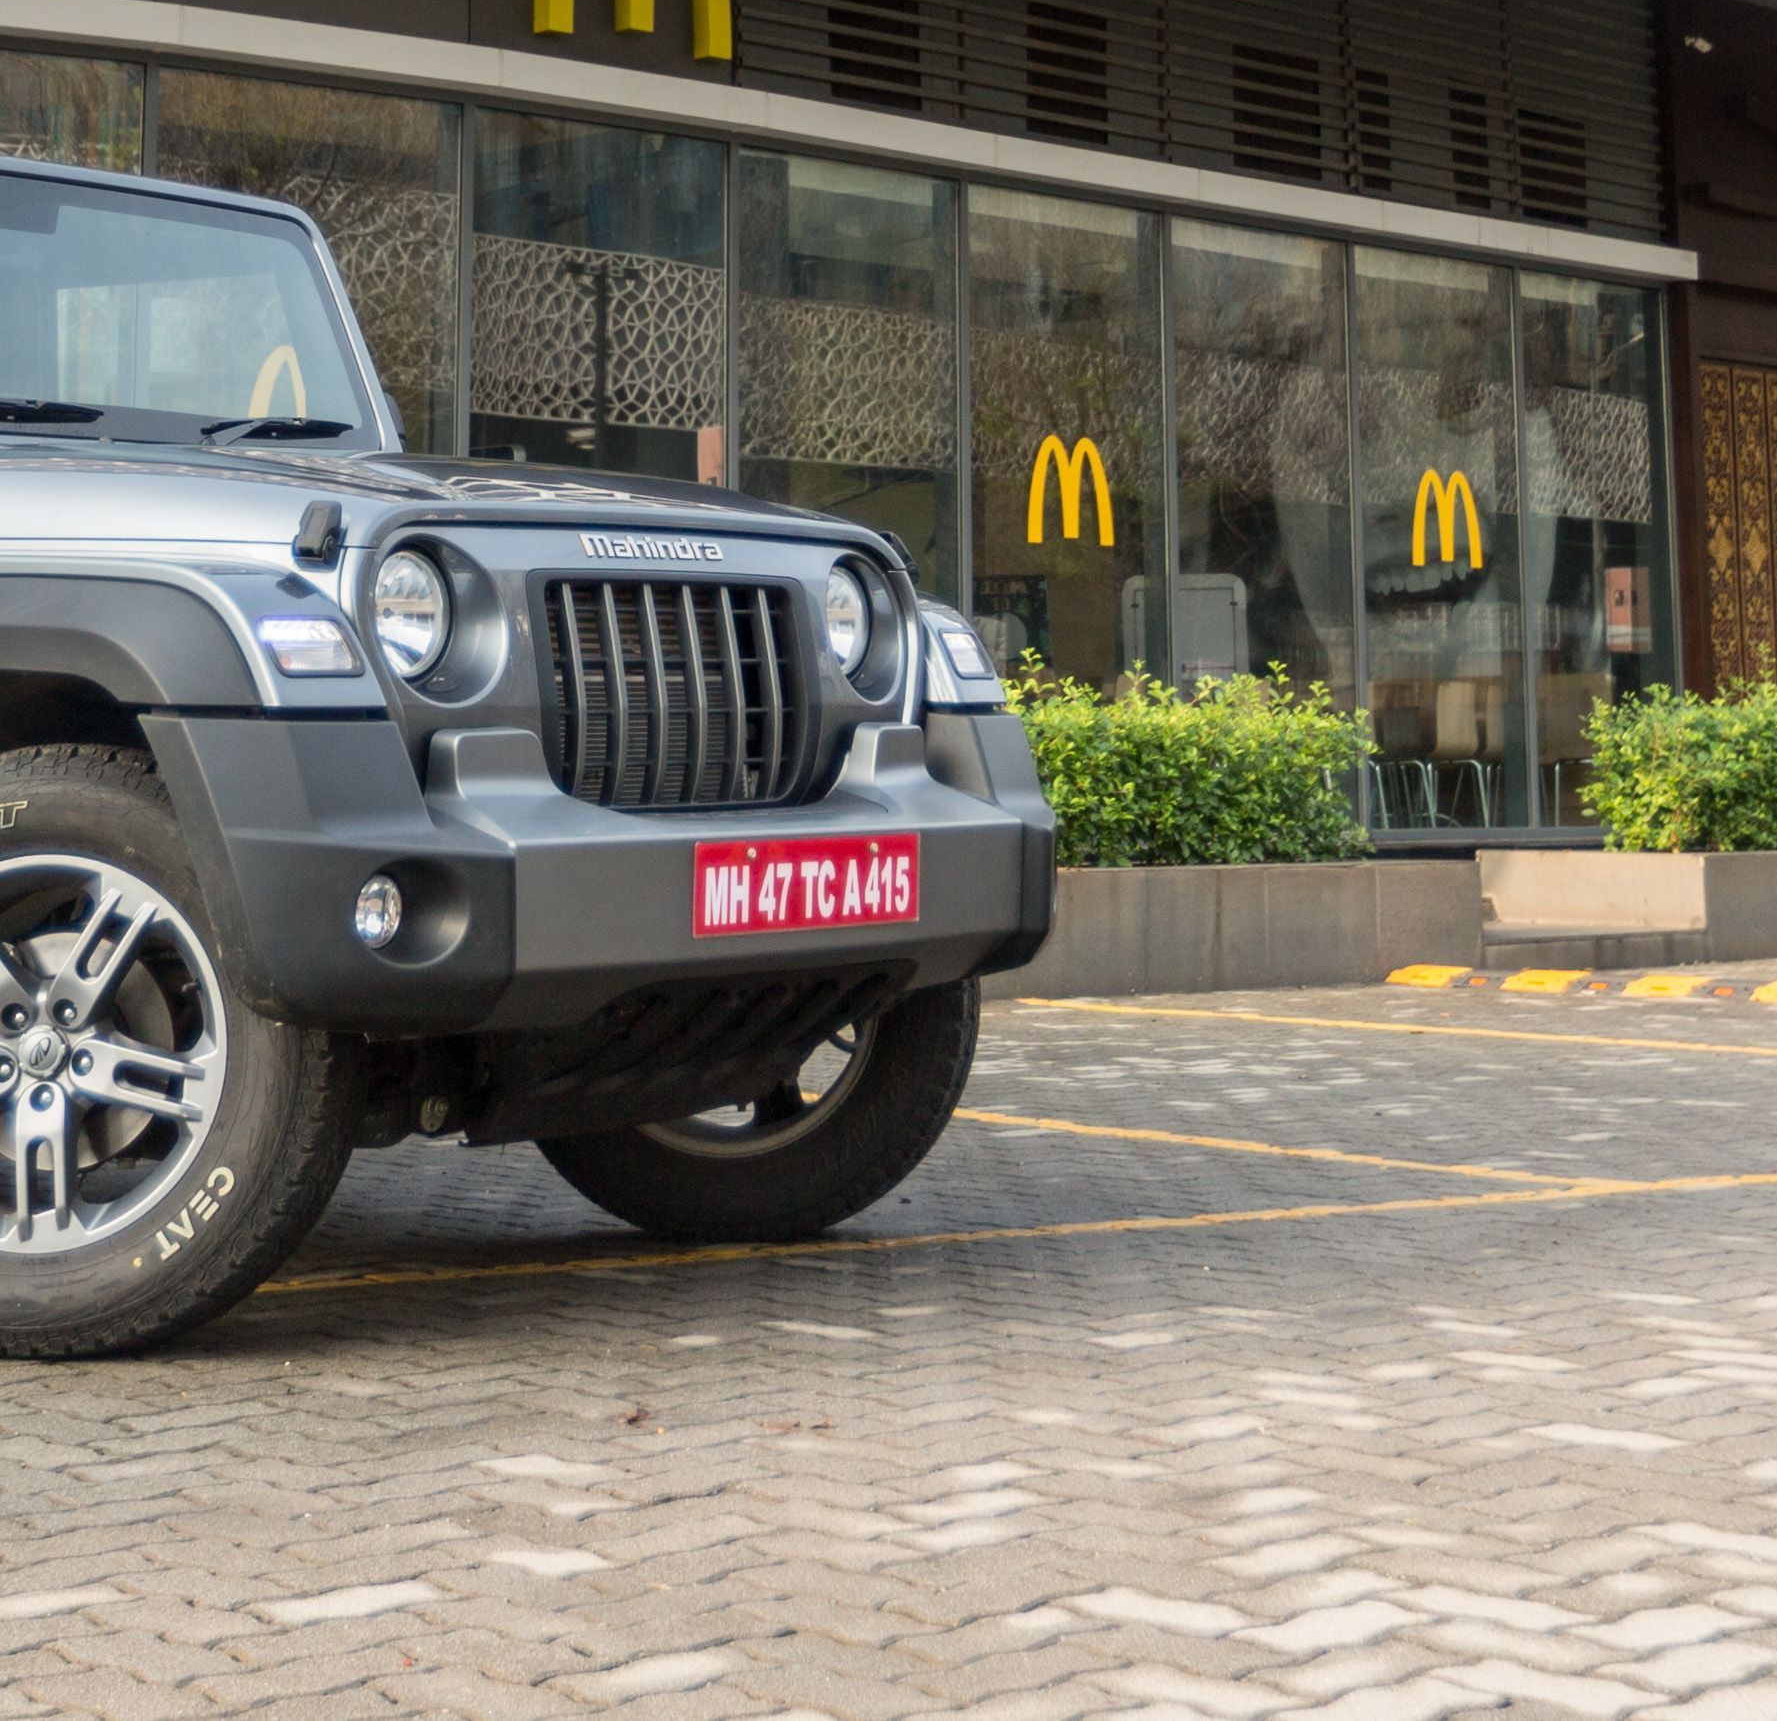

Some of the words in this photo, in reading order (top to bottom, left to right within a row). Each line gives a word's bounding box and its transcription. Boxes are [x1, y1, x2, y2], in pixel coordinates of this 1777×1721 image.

[578, 533, 725, 561] Mahindra
[704, 864, 750, 926] MH
[758, 862, 793, 921] 47
[801, 860, 836, 919] TC
[155, 1165, 235, 1261] CEAT
